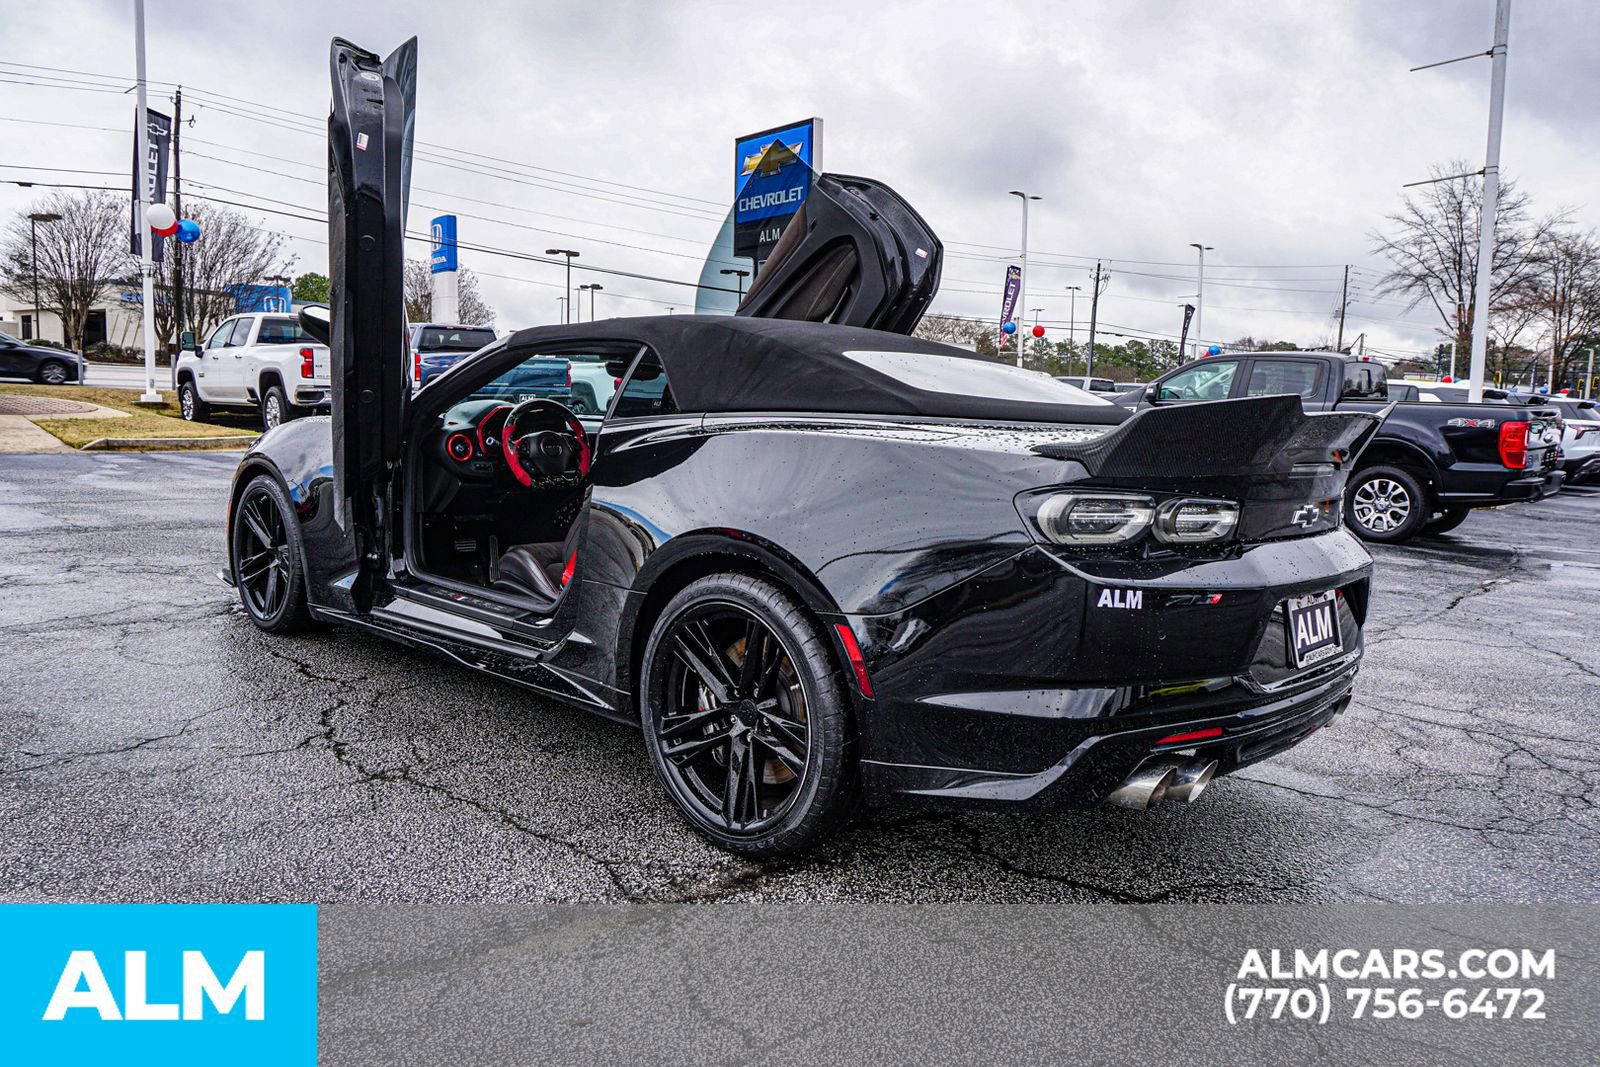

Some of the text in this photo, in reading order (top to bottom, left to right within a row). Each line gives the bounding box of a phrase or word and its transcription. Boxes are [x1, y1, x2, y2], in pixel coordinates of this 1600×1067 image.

[739, 186, 804, 212] CHEVROLET
[759, 227, 780, 242] ALM
[1097, 588, 1143, 609] ALM
[1297, 605, 1333, 649] ALM
